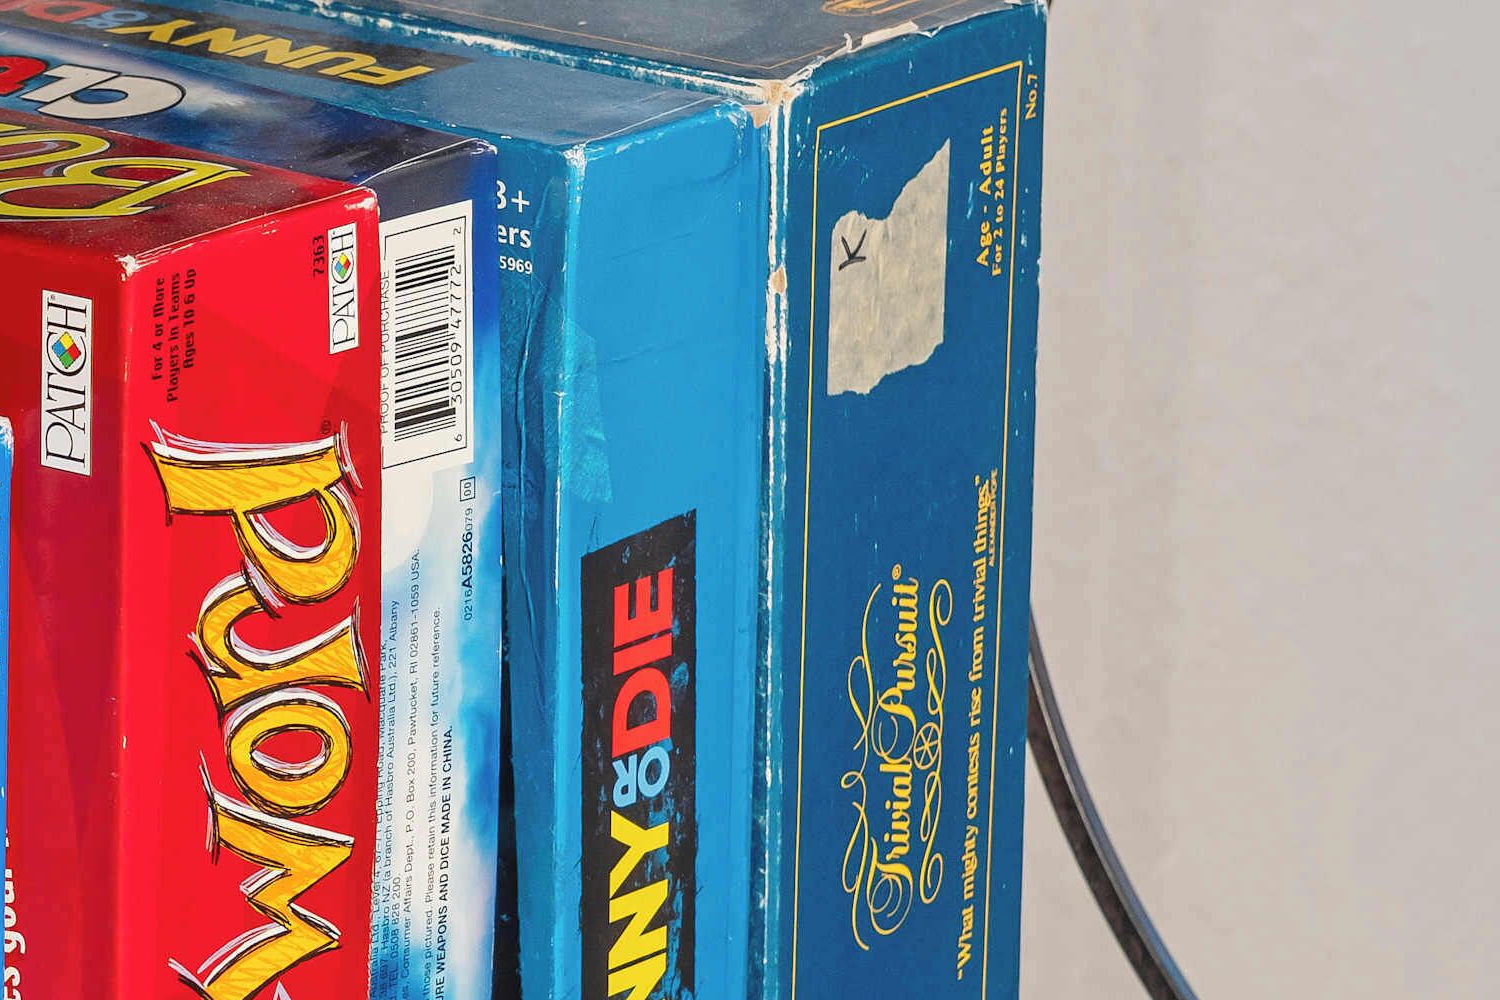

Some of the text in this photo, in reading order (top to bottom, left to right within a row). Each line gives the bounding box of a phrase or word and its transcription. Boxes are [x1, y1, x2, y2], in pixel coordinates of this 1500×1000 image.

[105, 19, 435, 86] FUNNY
[1024, 73, 1040, 121] No.7
[979, 124, 994, 196] Adult
[991, 107, 1009, 277] For 2 to 24 Players
[311, 234, 325, 277] 7363
[838, 229, 867, 271] K
[976, 219, 992, 267] Age
[168, 273, 181, 322] Teams
[184, 268, 198, 289] Up
[332, 224, 357, 346] PATCH
[151, 278, 165, 380] For 4 or More
[184, 310, 196, 326] 10
[381, 269, 391, 349] PURCHASE
[451, 227, 463, 442] 6 30509 47772 2
[167, 345, 182, 402] Players
[182, 331, 198, 369] Ages
[972, 557, 988, 623] trivial
[613, 567, 675, 757] DIE
[968, 626, 985, 682] from
[968, 687, 982, 727] rise
[442, 725, 453, 772] CHINA.
[965, 732, 983, 819] contests
[442, 776, 451, 790] IN
[612, 746, 670, 808] OR
[441, 793, 451, 833] MADE
[440, 837, 450, 869] DICE
[866, 757, 913, 936] Trivial
[963, 824, 983, 900] mighty
[439, 874, 449, 901] AND
[436, 906, 448, 972] WEAPONS
